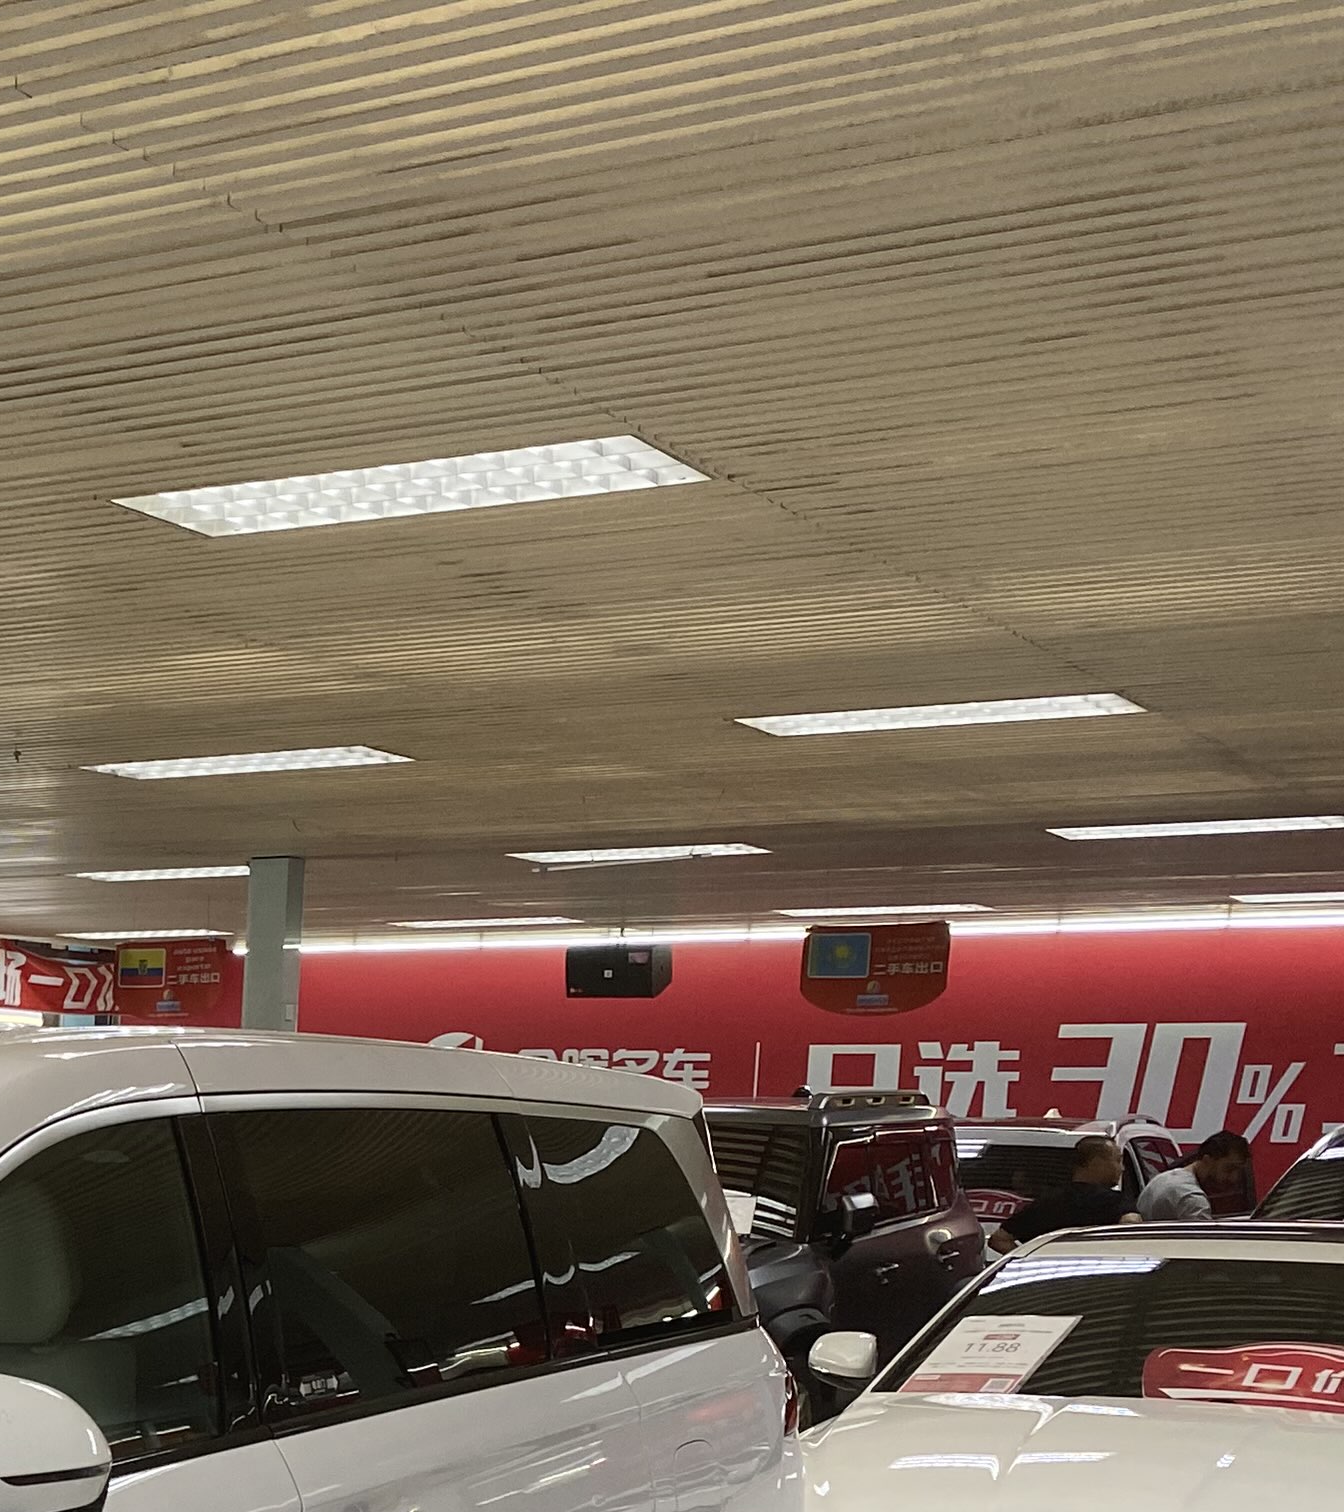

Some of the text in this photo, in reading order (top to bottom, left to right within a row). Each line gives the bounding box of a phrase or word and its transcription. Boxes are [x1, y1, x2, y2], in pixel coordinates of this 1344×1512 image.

[873, 961, 944, 976] 二手车出口
[166, 972, 221, 986] 二手车出口
[964, 1342, 1021, 1353] 11.88
